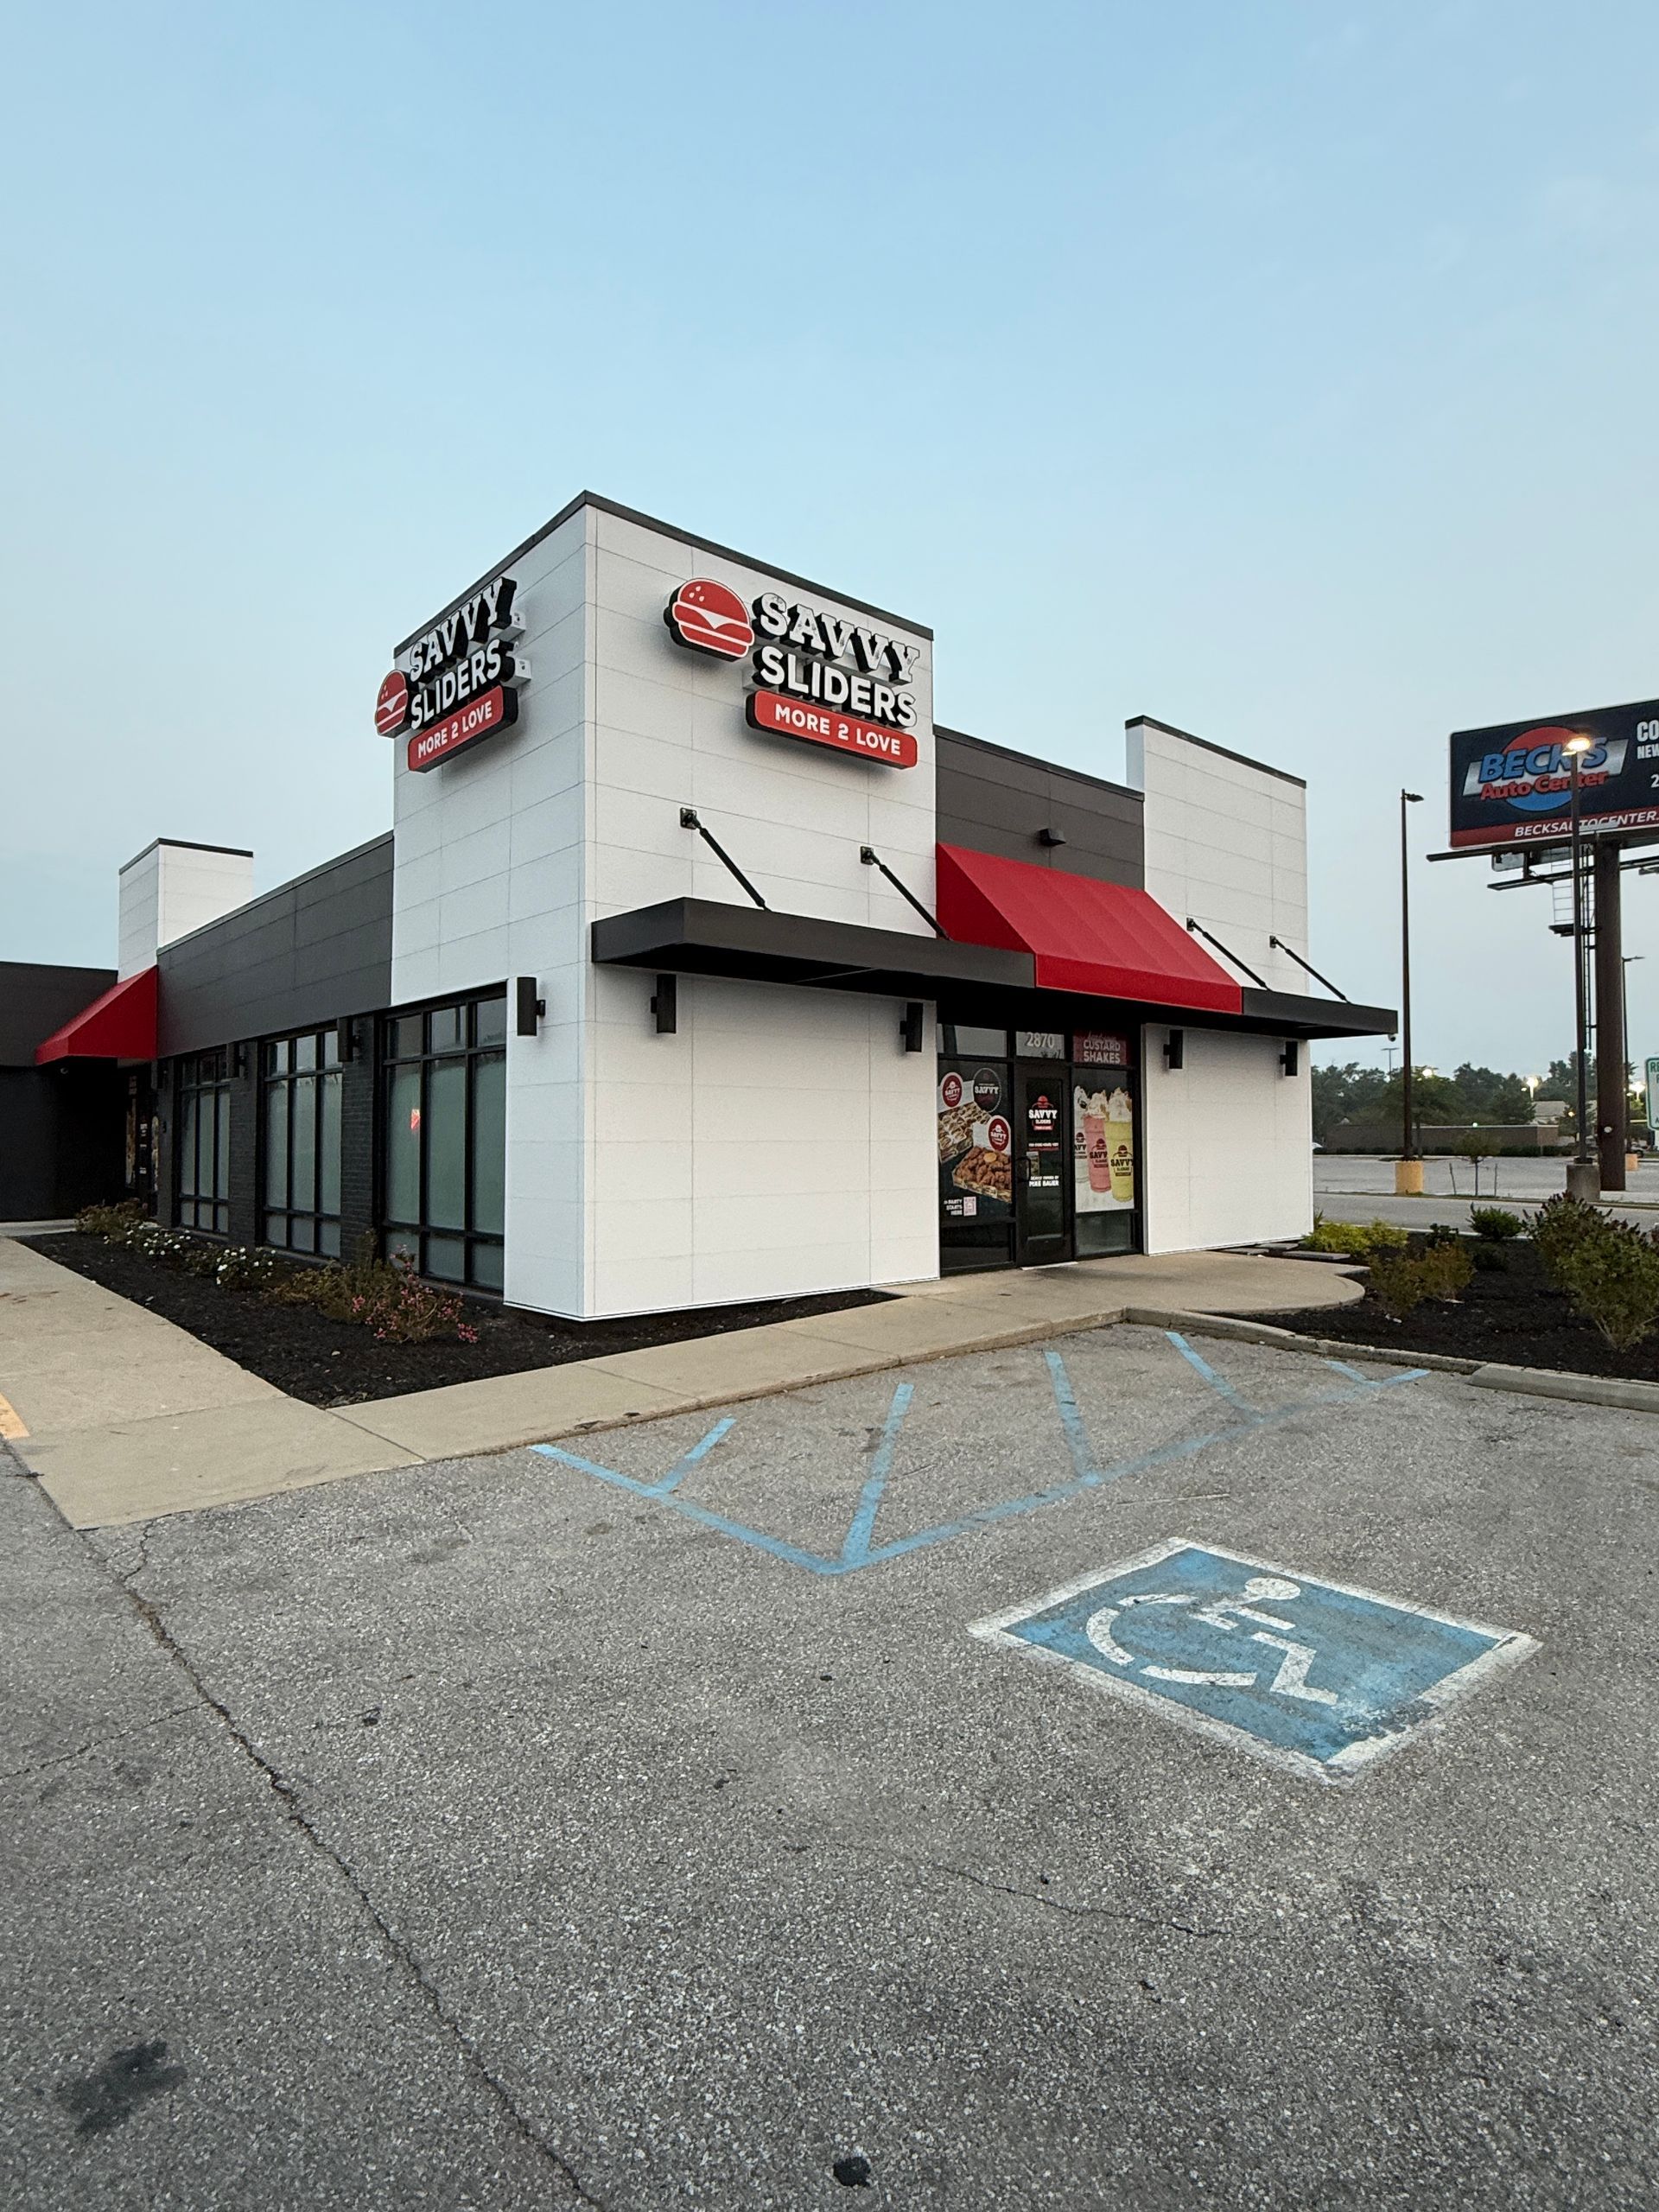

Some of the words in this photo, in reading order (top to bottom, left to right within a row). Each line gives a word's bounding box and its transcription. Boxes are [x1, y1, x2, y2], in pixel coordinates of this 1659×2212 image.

[410, 577, 504, 683] SAVVY
[760, 593, 920, 683] SAVVY
[410, 639, 503, 730] SLIDERS
[760, 645, 918, 728] SLIDERS
[417, 728, 448, 759] MORE
[451, 722, 459, 740] 2
[461, 700, 493, 734] LOVE
[774, 702, 830, 734] MORE
[837, 722, 849, 741] 2
[855, 727, 901, 756] LOVE
[1478, 736, 1609, 784] BECKS
[1479, 780, 1532, 801] Auto
[1535, 770, 1609, 793] Center
[1027, 1032, 1055, 1049] 2870
[1083, 1039, 1122, 1052] CUSTARD
[1083, 1051, 1122, 1064] SHAKES
[974, 1085, 1000, 1095] SAVVY
[1028, 1109, 1058, 1120] SAVVY
